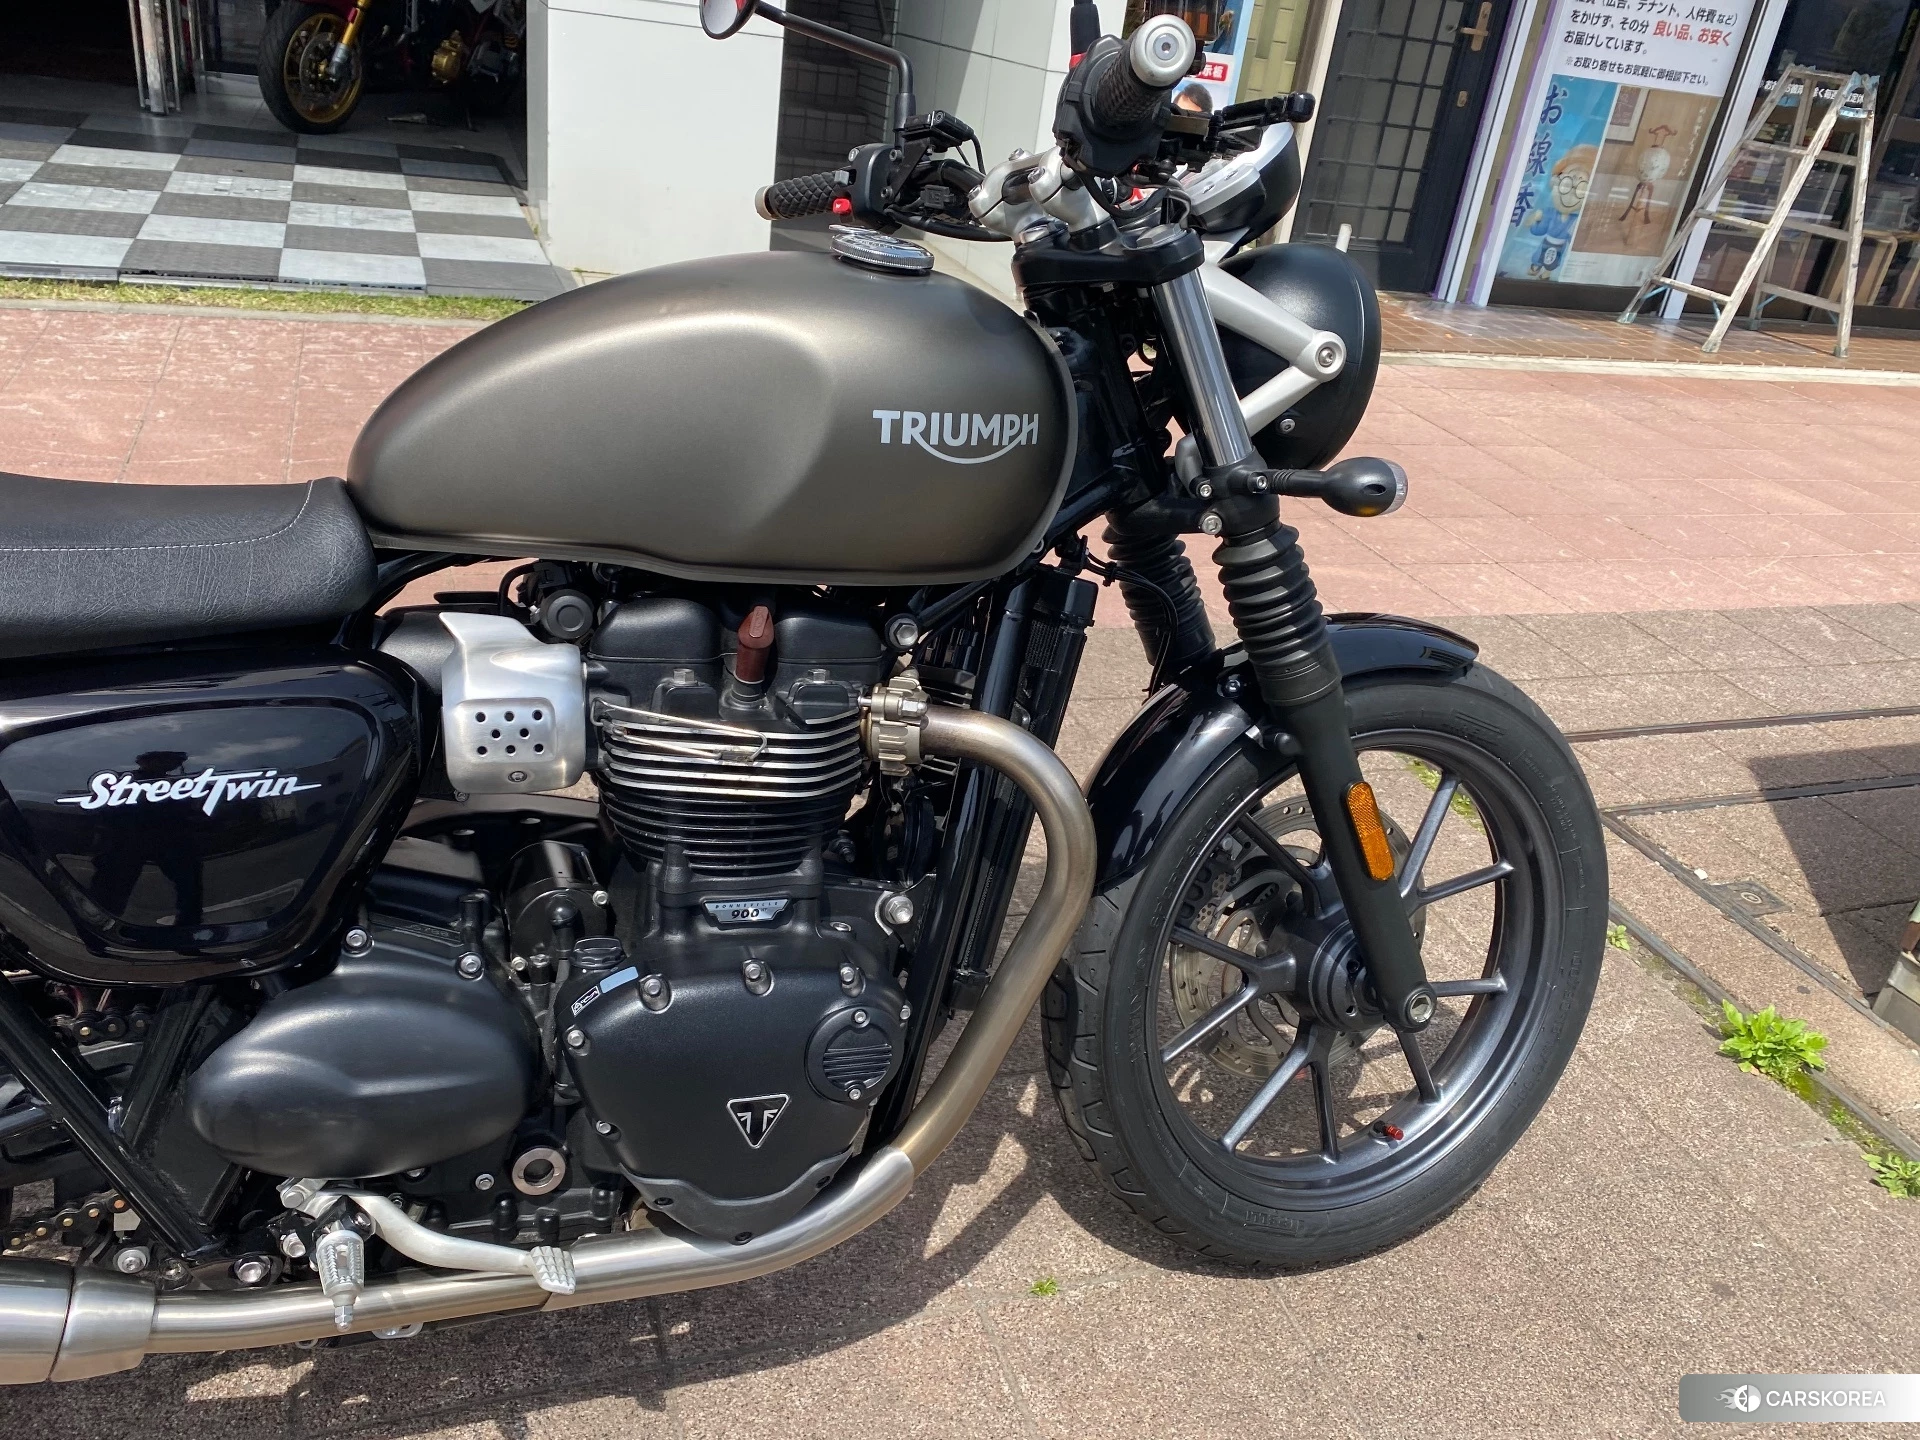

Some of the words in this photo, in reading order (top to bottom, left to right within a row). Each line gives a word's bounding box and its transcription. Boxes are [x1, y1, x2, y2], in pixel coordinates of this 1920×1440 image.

[1563, 30, 1648, 55] お届けしています。
[1570, 9, 1649, 34] をかけず、その分
[1653, 20, 1733, 47] 良い品、お安く
[872, 410, 1039, 464] TRIUMPH
[731, 908, 760, 919] 900
